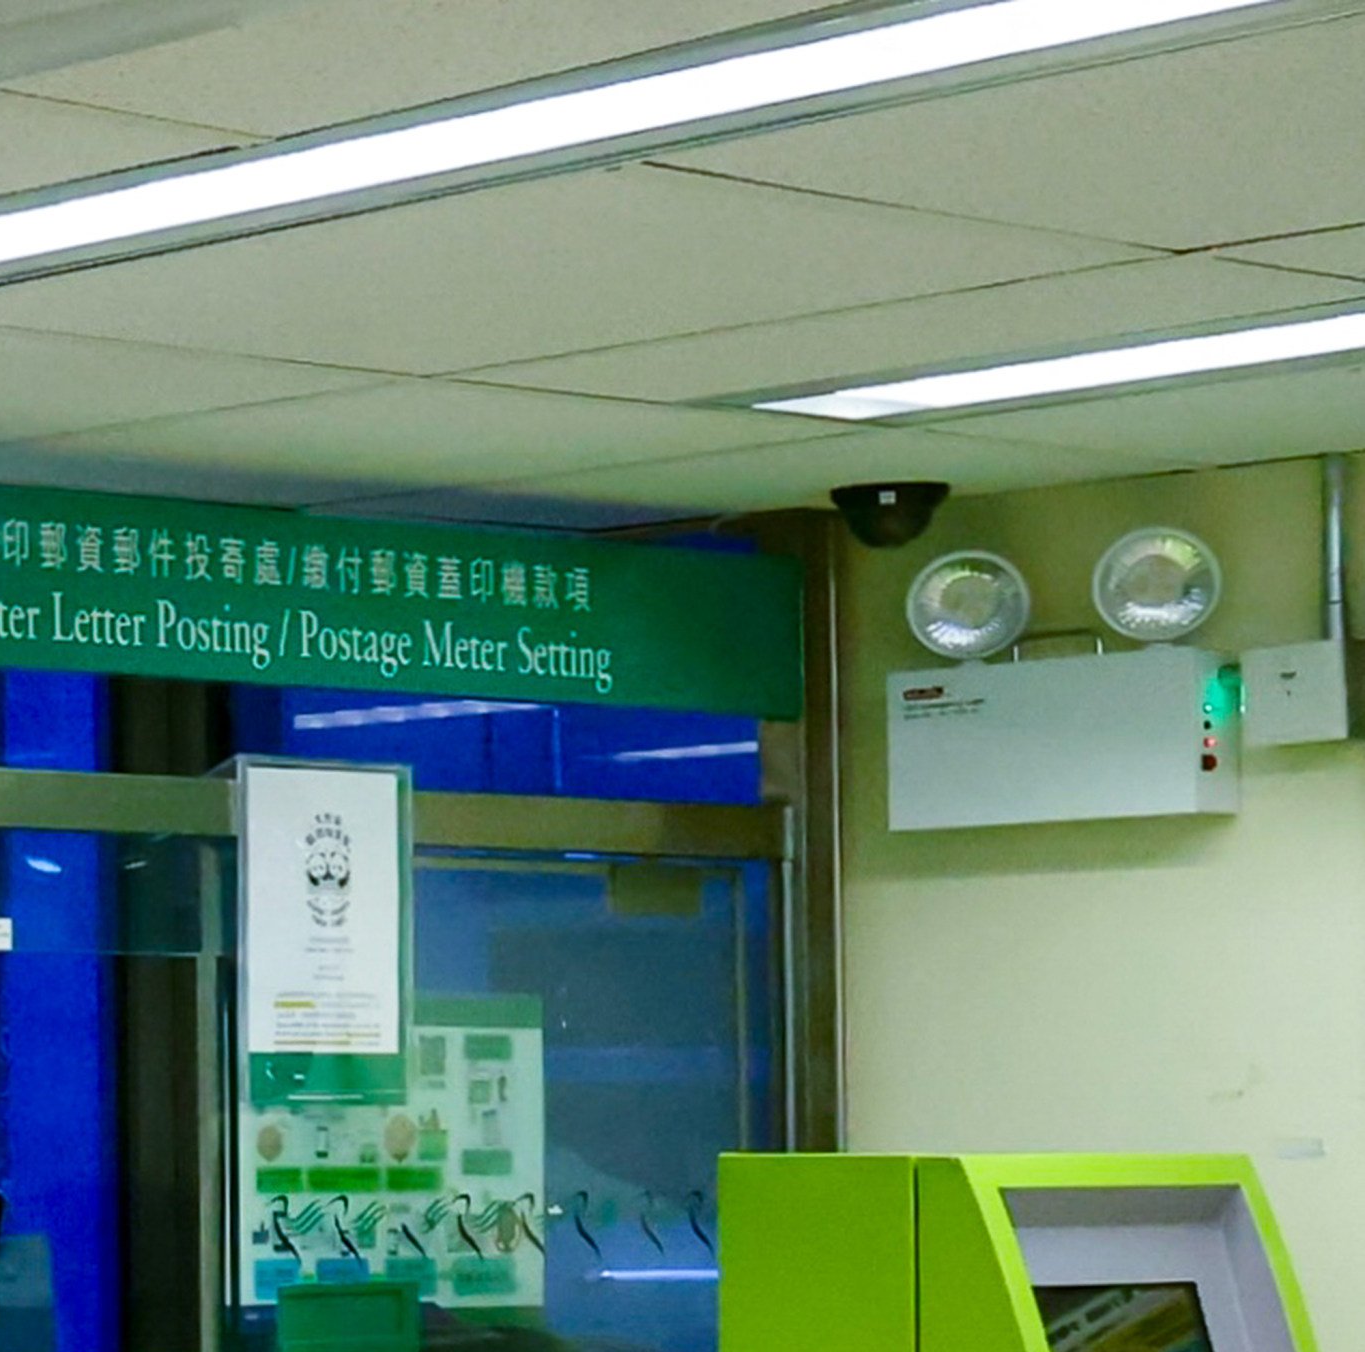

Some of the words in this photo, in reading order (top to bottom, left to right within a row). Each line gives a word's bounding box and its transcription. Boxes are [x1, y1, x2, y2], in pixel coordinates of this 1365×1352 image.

[52, 591, 146, 648] Letter
[157, 600, 270, 670] Posting
[300, 610, 412, 678] Postage
[423, 619, 508, 673] Meter
[517, 626, 612, 690] Setting
